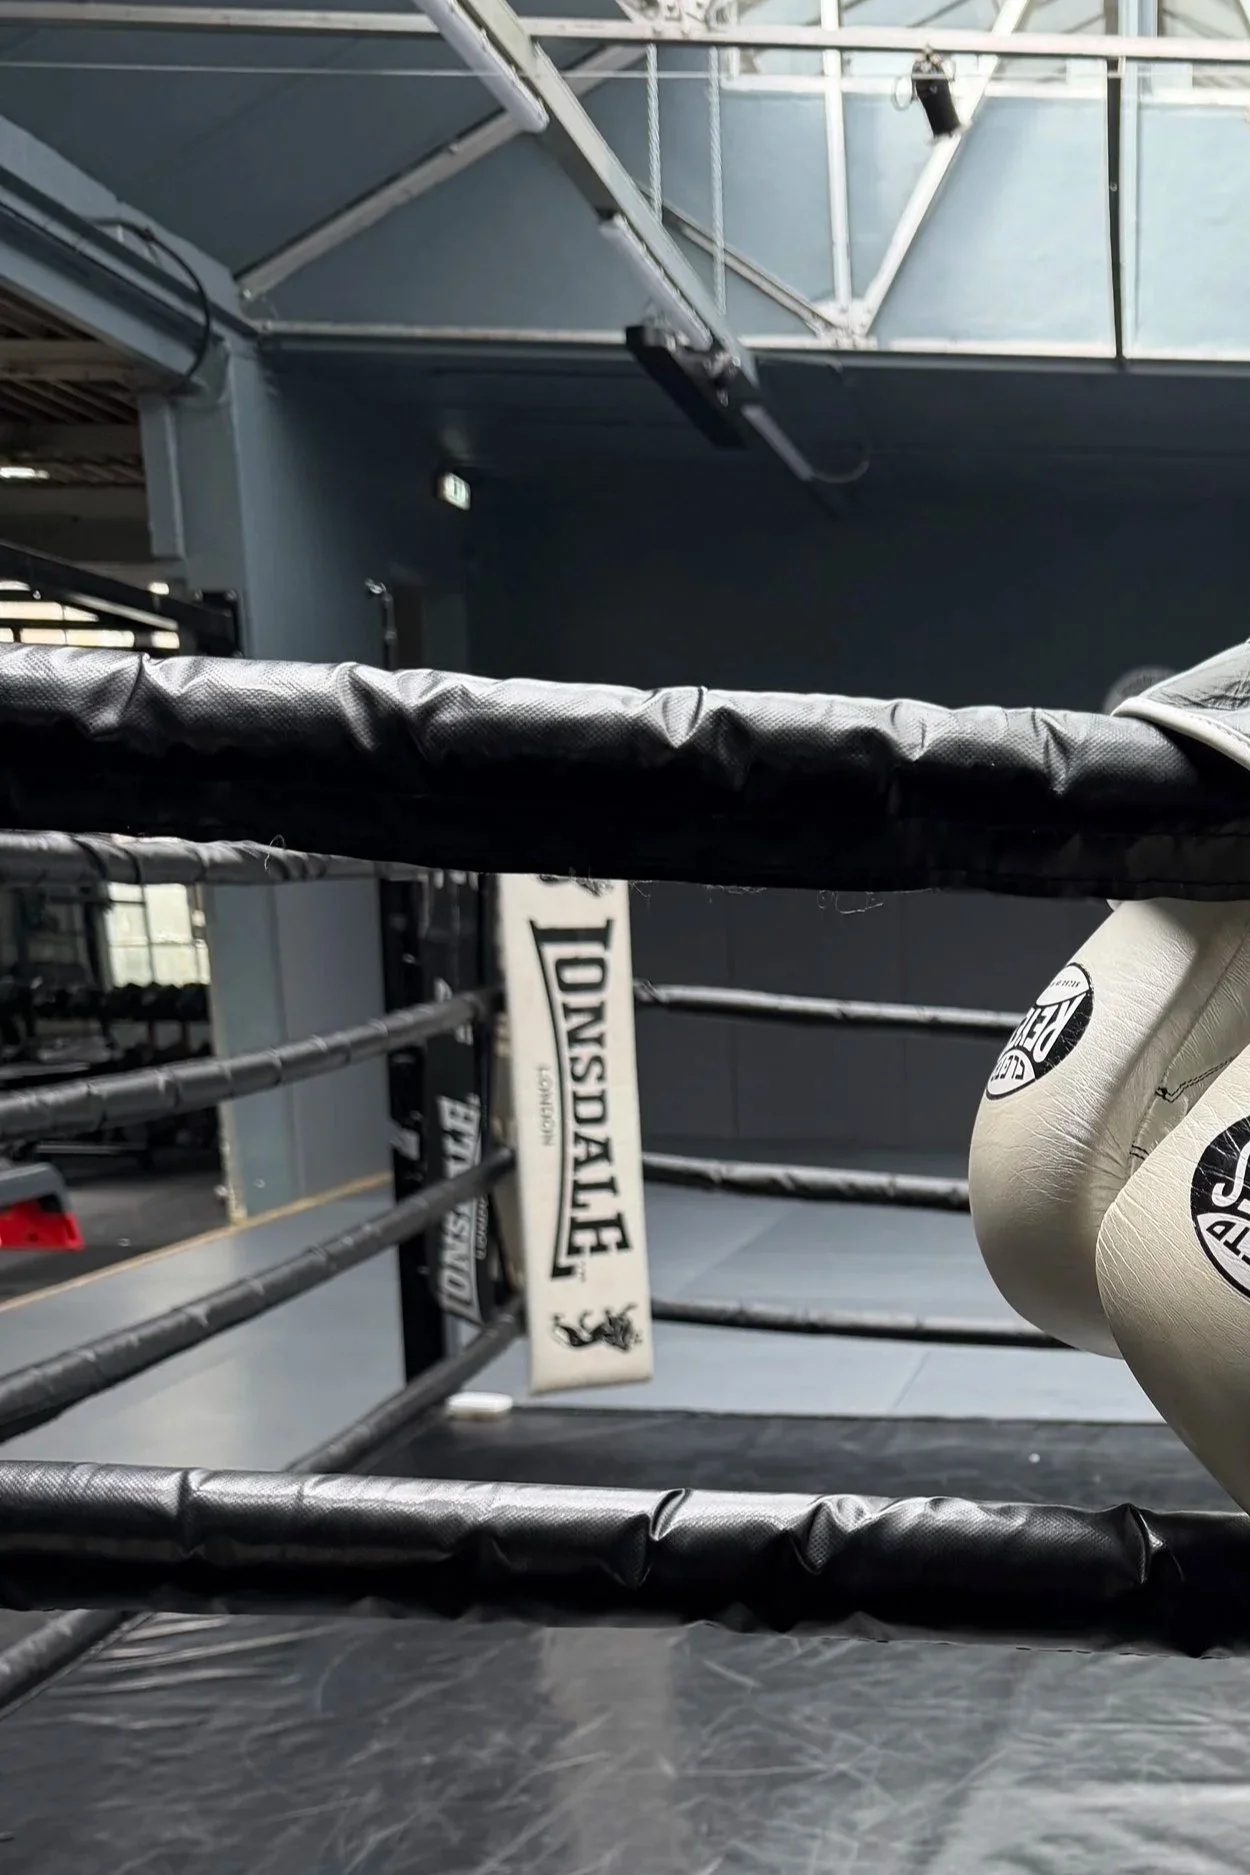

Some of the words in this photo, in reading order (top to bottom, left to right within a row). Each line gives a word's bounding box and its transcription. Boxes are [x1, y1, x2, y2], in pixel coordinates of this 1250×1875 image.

[528, 917, 634, 1281] LONSDALE
[996, 992, 1087, 1064] REYE
[438, 1092, 487, 1322] LONSLE
